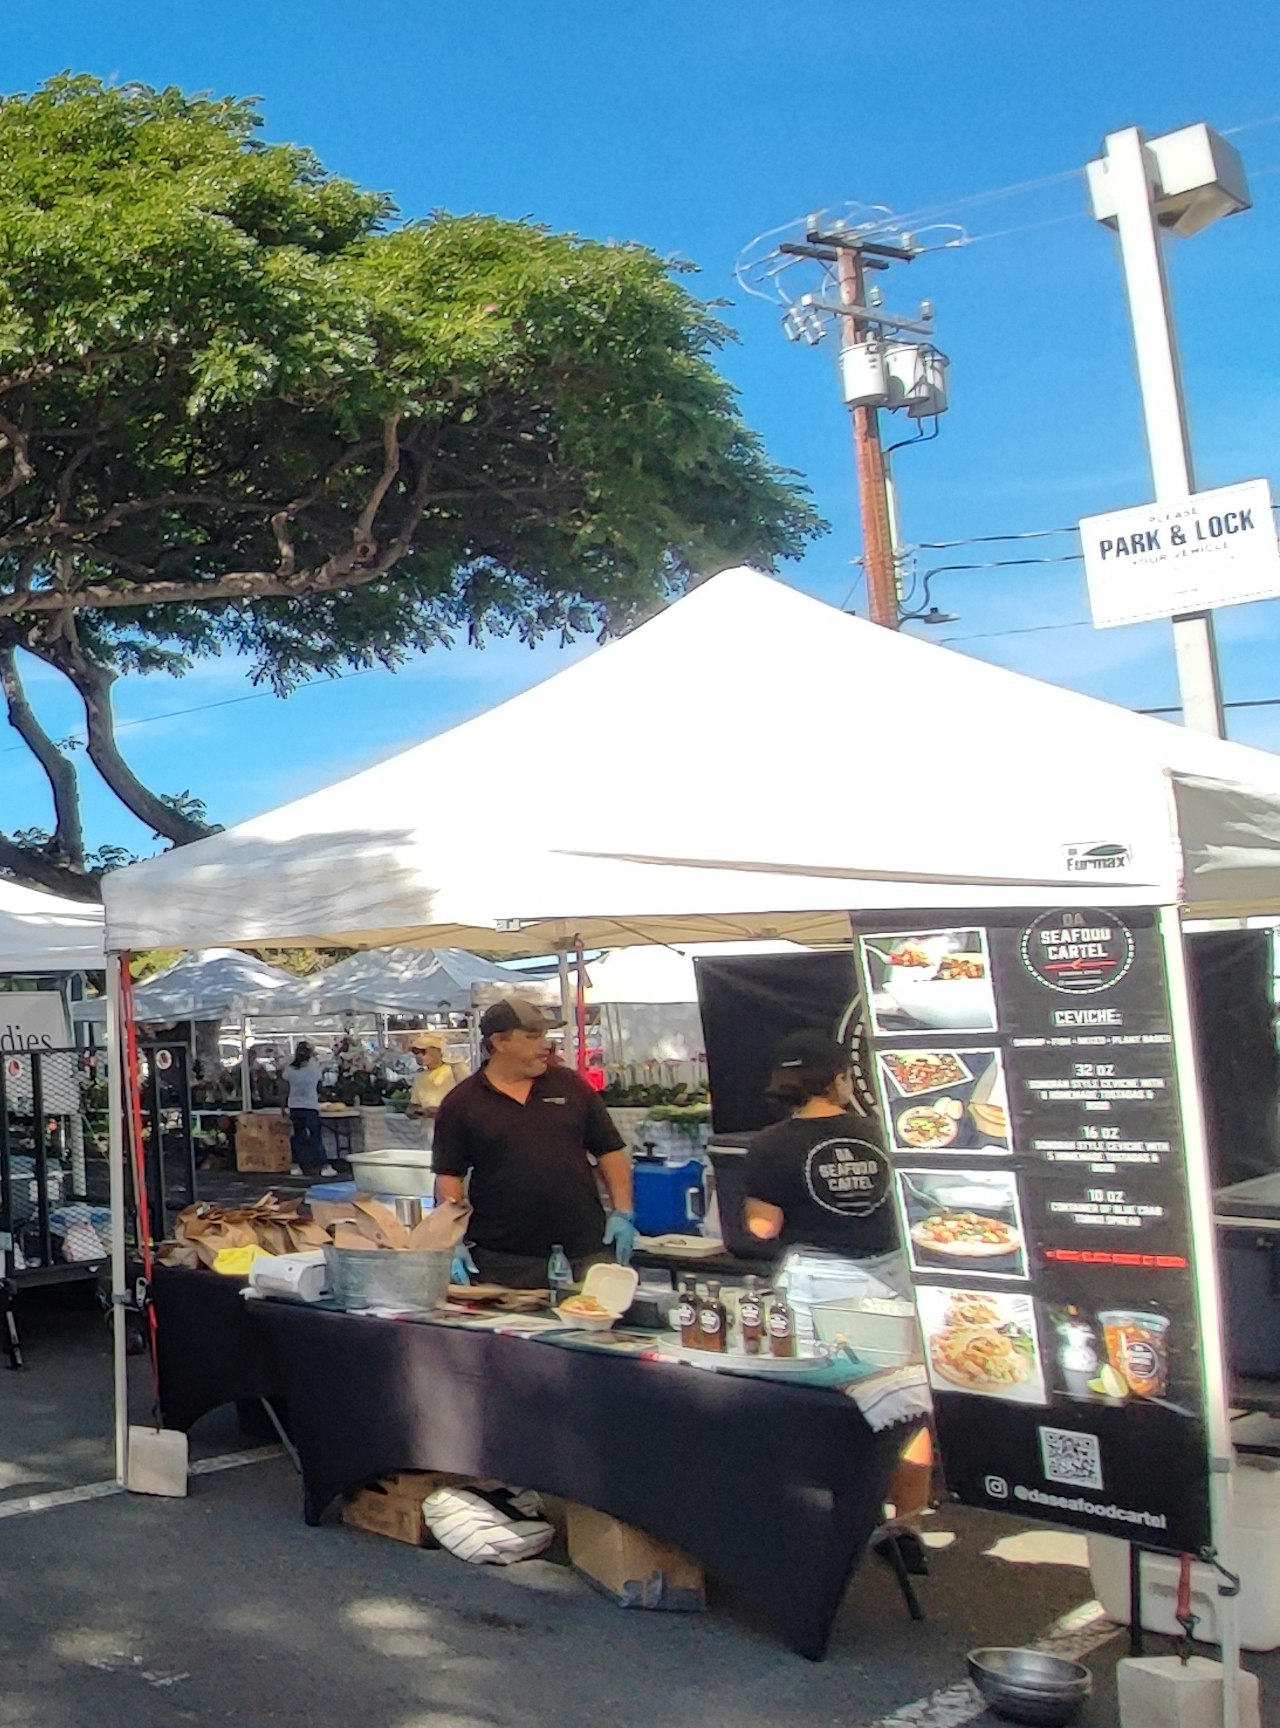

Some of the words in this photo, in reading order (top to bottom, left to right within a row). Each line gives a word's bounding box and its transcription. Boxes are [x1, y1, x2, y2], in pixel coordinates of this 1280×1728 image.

[1100, 529, 1161, 560] PARK
[1170, 524, 1186, 546] &
[1195, 508, 1255, 541] LOCK
[1062, 912, 1086, 926] DA
[1040, 927, 1112, 945] SEAFOOD
[1048, 943, 1109, 960] CARTEL
[1075, 1063, 1094, 1077] 32
[1080, 1125, 1099, 1139] 16
[1087, 1188, 1104, 1202] 10
[1013, 1484, 1168, 1530] @daseafoodcartel
